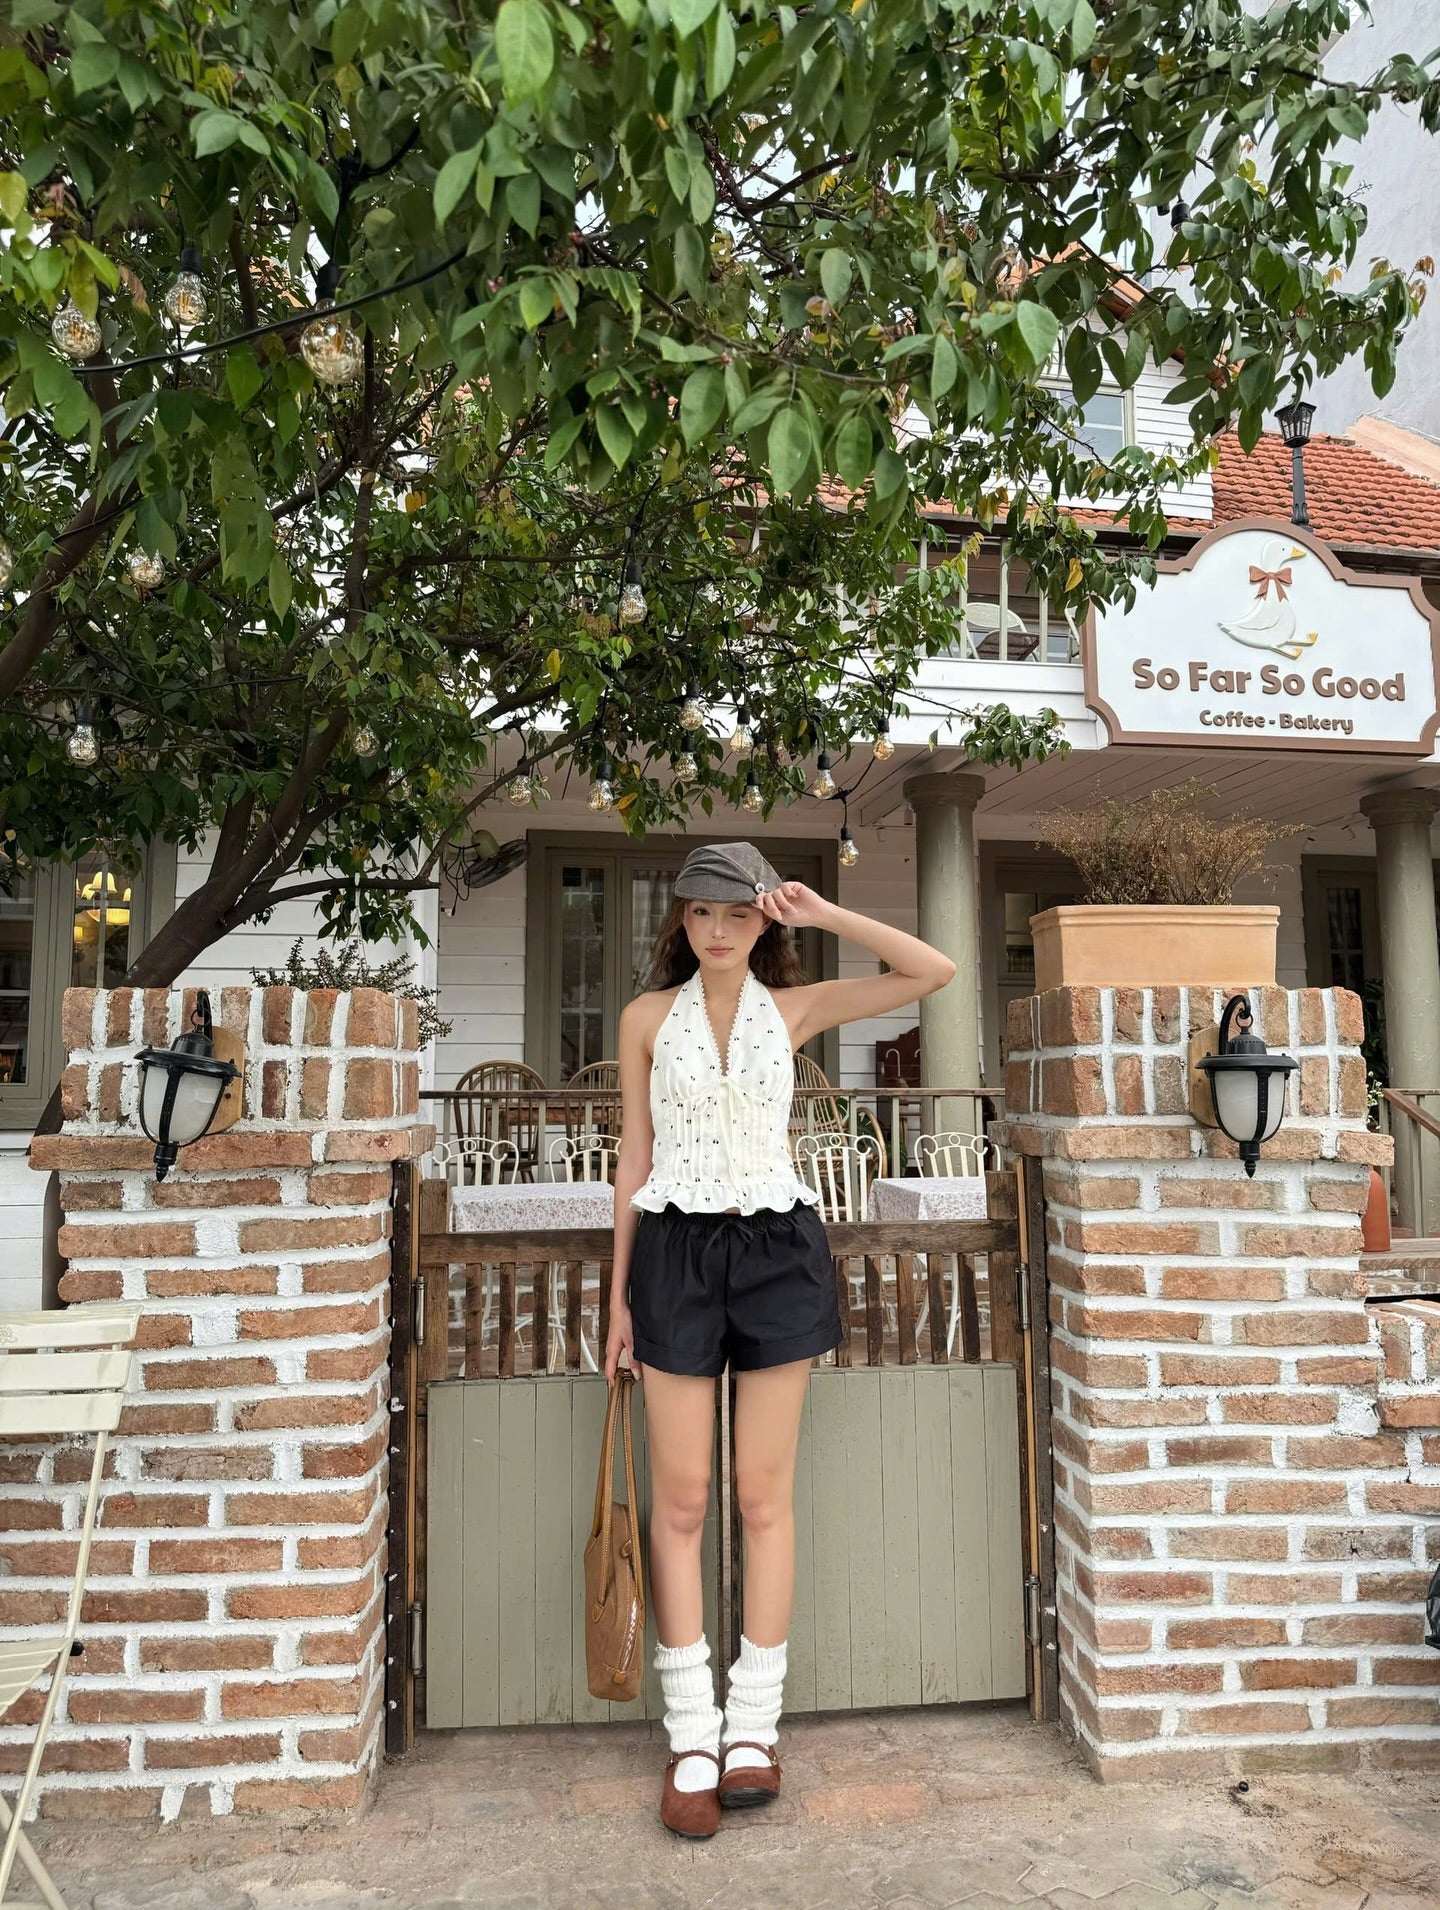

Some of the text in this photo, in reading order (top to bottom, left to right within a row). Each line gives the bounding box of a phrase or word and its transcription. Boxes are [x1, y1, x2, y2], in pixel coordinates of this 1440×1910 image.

[1132, 658, 1406, 702] So Far So Good
